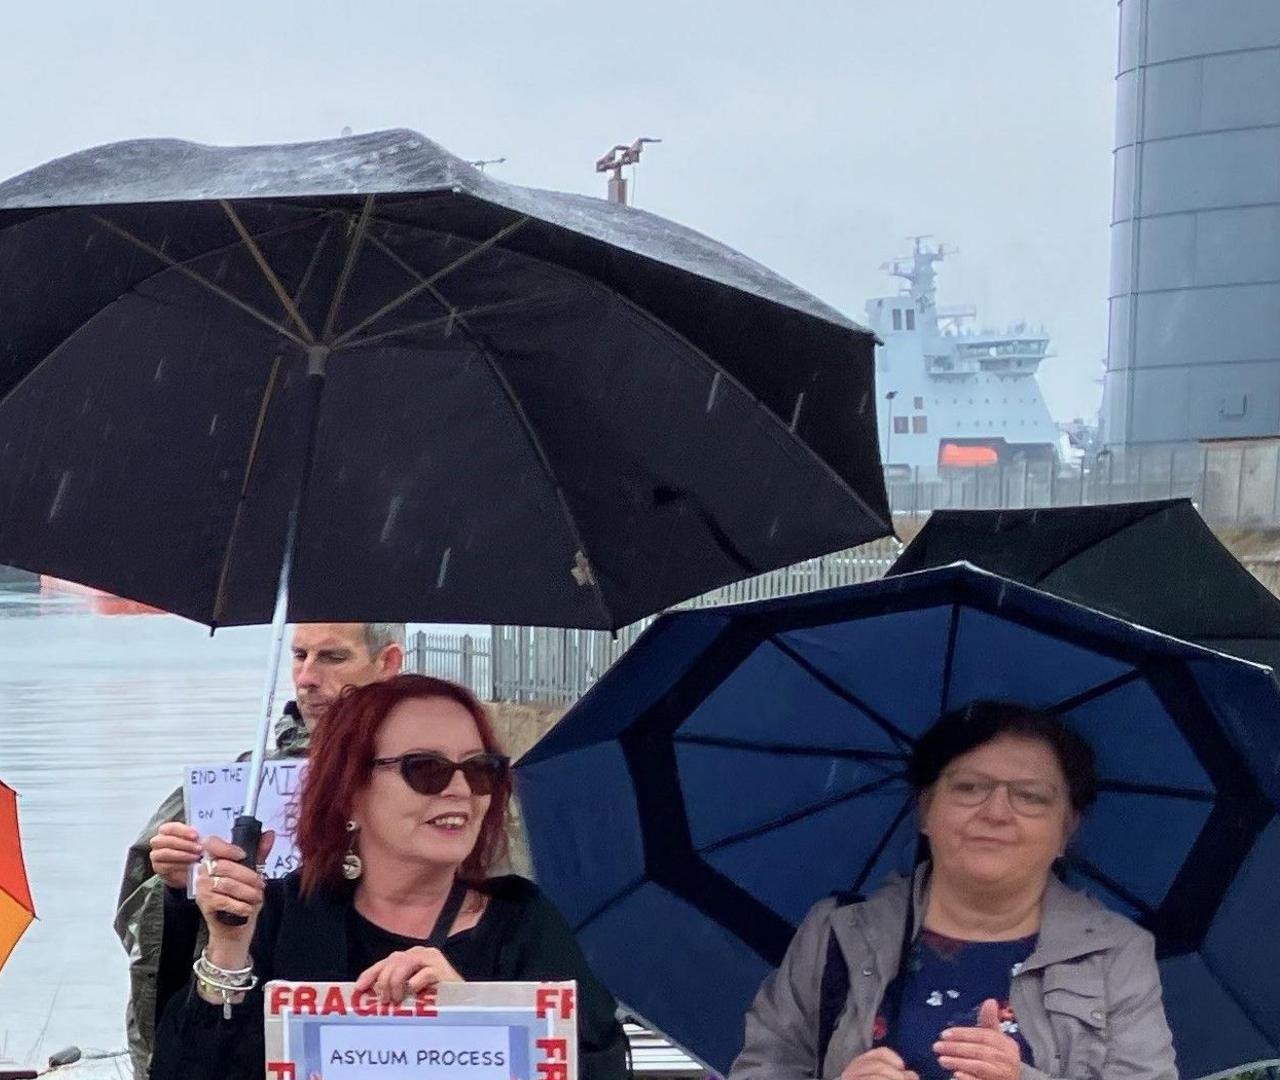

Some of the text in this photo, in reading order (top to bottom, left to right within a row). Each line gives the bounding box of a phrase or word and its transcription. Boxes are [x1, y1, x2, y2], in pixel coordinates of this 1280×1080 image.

[191, 770, 217, 785] END
[221, 767, 243, 782] THE
[330, 1050, 506, 1067] ASYLUM PROCESS
